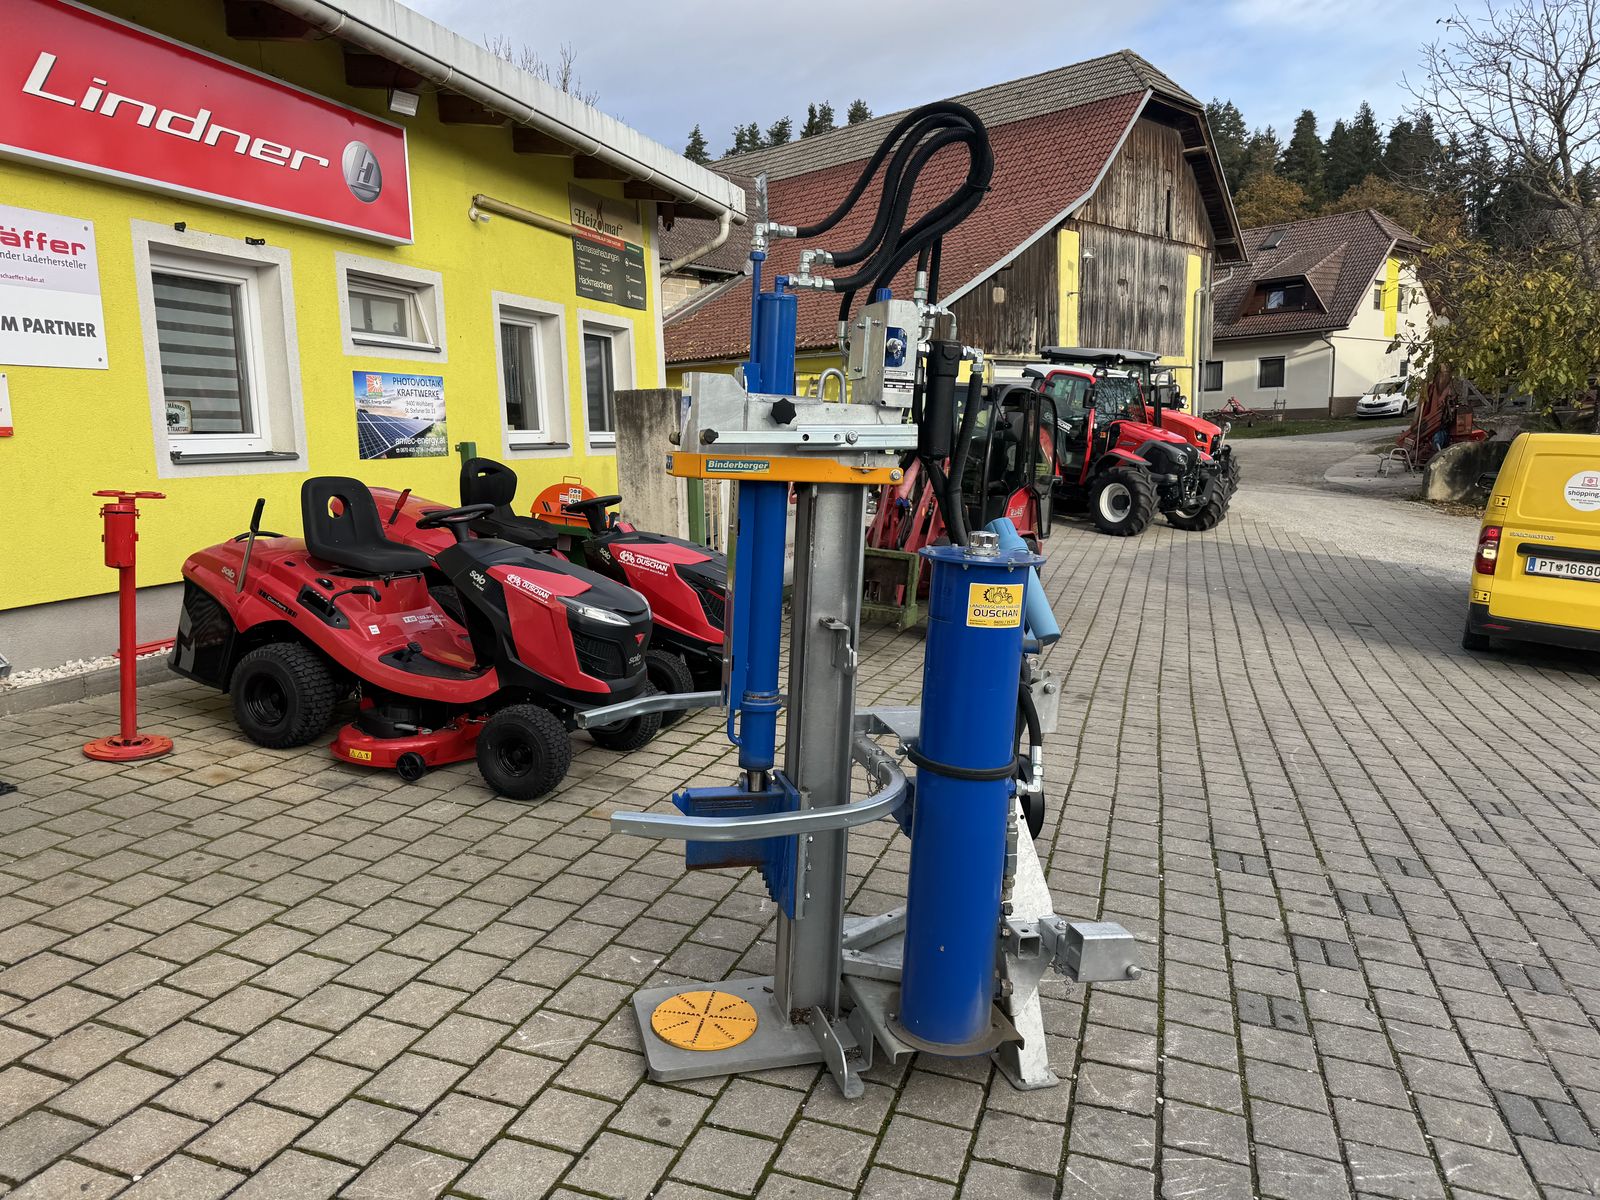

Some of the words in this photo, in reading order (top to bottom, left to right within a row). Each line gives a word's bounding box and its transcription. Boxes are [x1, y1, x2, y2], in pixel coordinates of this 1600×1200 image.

[22, 52, 330, 171] Lindner
[23, 253, 87, 270] Laderhersteller
[23, 317, 97, 338] PARTNER
[392, 376, 442, 387] PHOTOVOLTAIK
[396, 388, 440, 398] KRAFTWERKE
[707, 460, 769, 471] Binderberger
[221, 566, 236, 578] solo
[636, 557, 668, 572] OUSCHAN
[1540, 560, 1555, 572] PT
[1564, 562, 1600, 577] 16680
[469, 569, 486, 585] solo
[521, 580, 550, 600] OUSCHAN
[973, 608, 1018, 618] OUSCHAN
